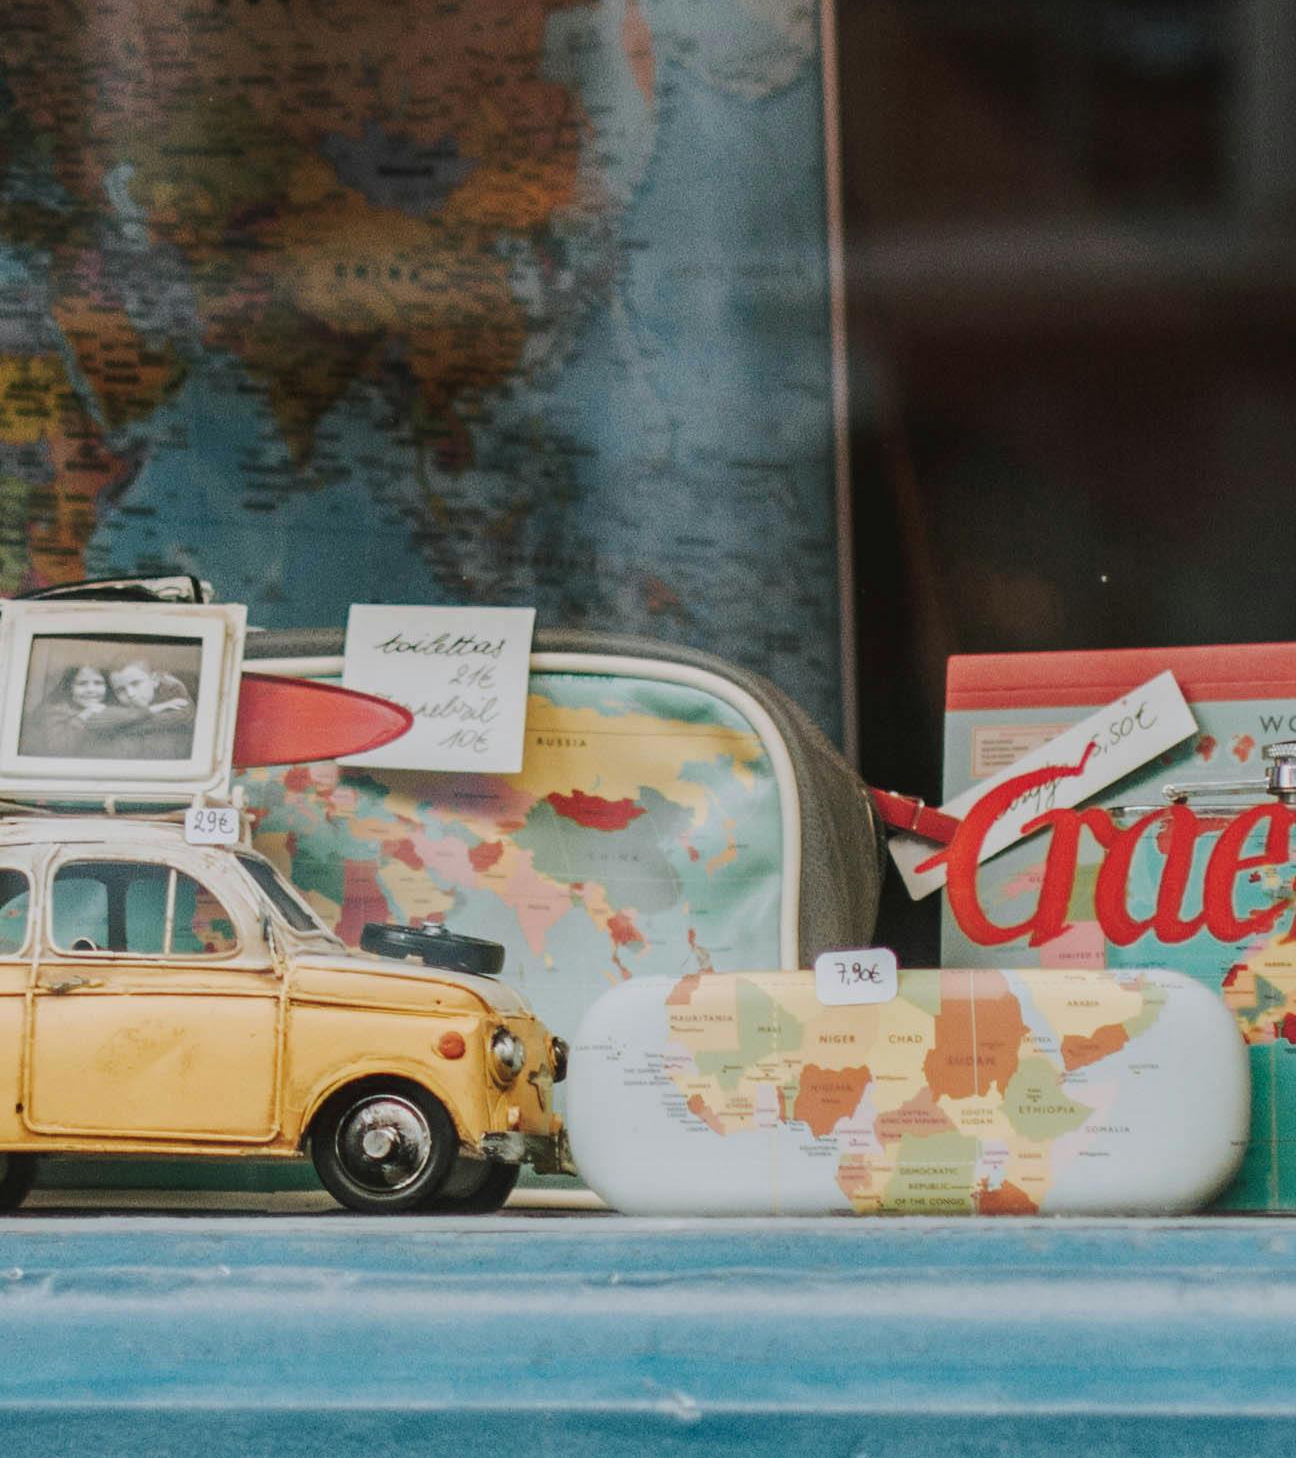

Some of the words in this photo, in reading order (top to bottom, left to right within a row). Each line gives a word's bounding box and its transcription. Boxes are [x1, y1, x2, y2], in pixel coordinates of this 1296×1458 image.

[537, 736, 588, 748] RUSSIA
[192, 812, 235, 834] 29€
[834, 963, 884, 986] 7,90€
[819, 1035, 856, 1045] NIGER
[889, 1035, 923, 1045] CHAD
[1019, 1106, 1076, 1115] ETHIOPIA
[928, 1198, 966, 1207] CONGO
